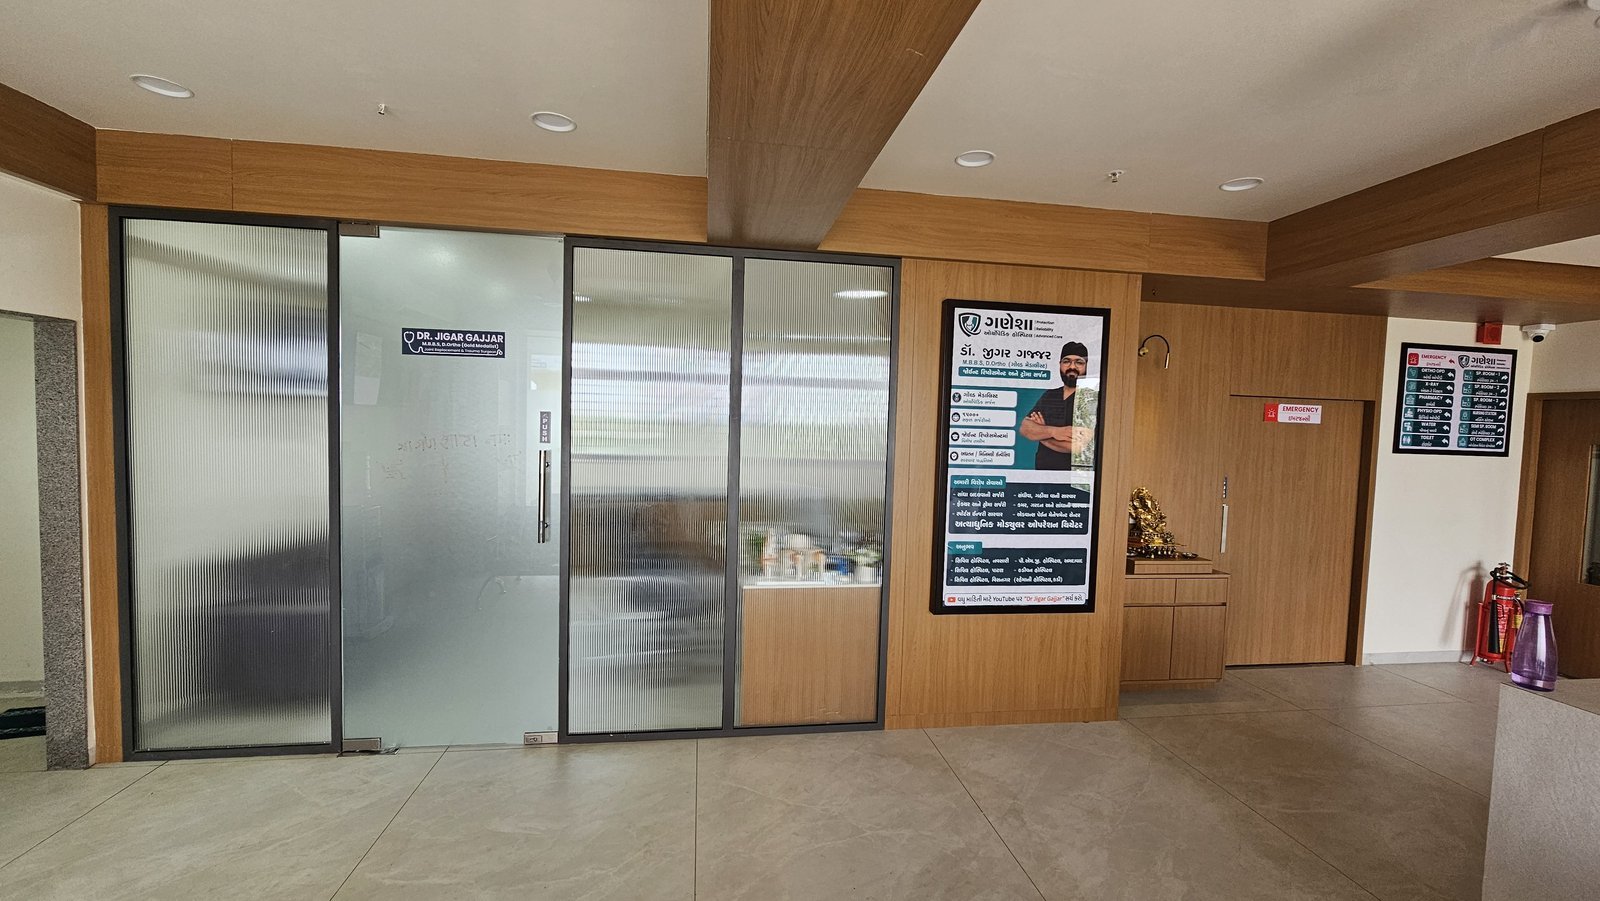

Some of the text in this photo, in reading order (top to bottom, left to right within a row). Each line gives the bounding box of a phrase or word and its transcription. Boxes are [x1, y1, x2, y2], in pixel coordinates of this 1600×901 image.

[984, 313, 1032, 330] ગણેશા
[417, 332, 503, 342] DR. JIGAR GAJJAR
[983, 347, 1011, 359] જીગર
[1016, 349, 1051, 360] ગજ્જર
[1471, 355, 1496, 365] ગણેશા
[1028, 520, 1058, 528] ઓપરેશન
